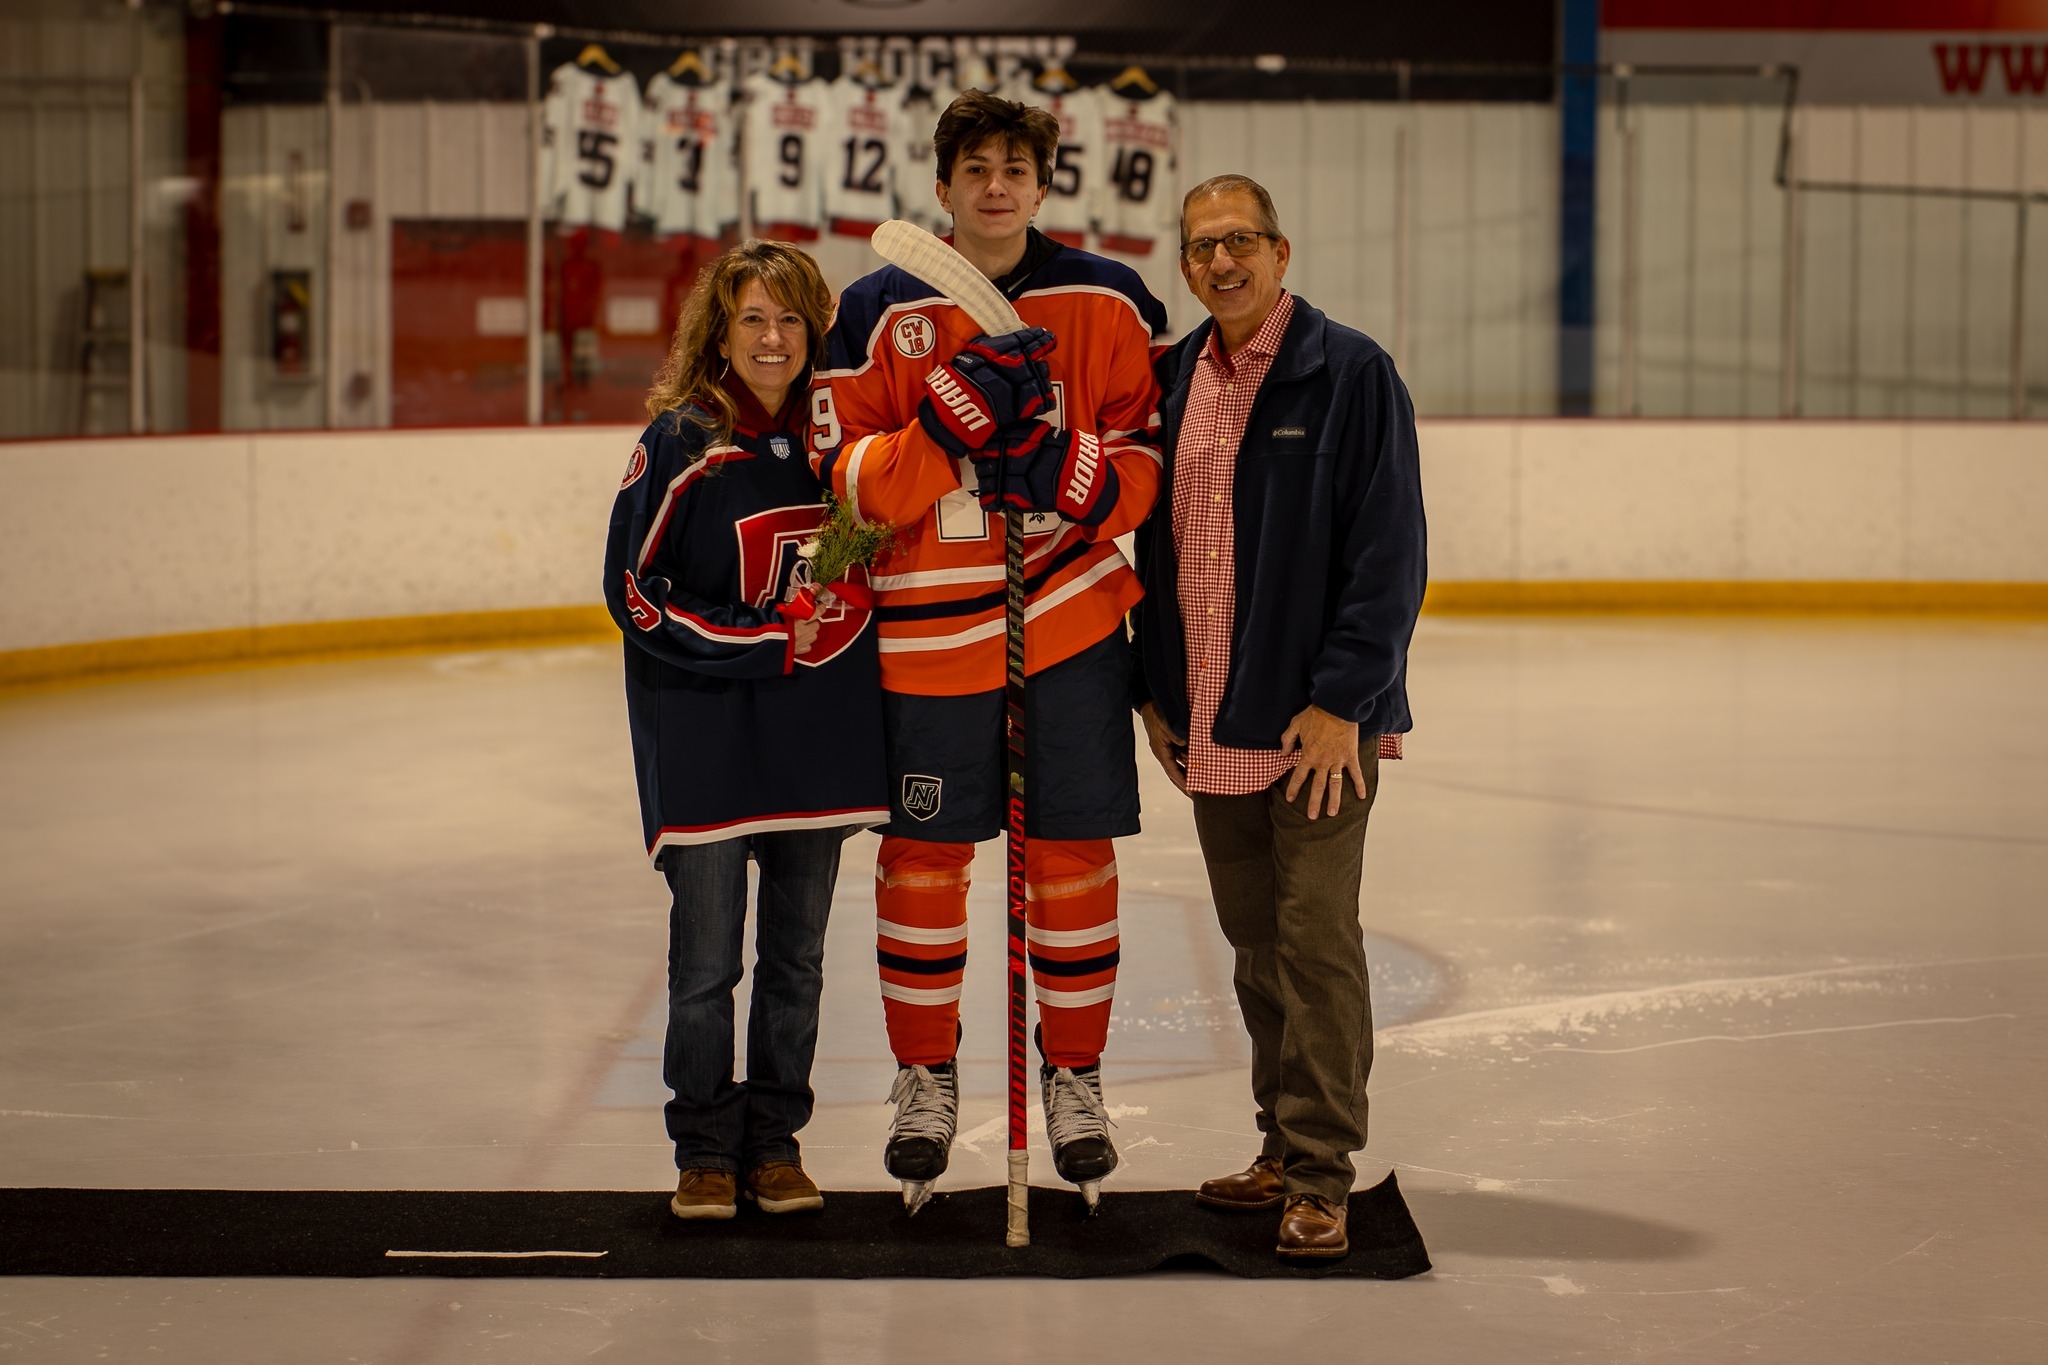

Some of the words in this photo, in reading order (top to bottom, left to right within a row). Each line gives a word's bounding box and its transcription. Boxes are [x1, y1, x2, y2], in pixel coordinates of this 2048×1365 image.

[578, 130, 617, 188] 5
[781, 135, 803, 188] 9
[843, 137, 887, 192] 12
[1052, 145, 1083, 196] 5
[1112, 147, 1153, 201] 48
[901, 320, 923, 338] CW
[908, 337, 925, 354] 18
[811, 386, 842, 450] 9
[1277, 428, 1305, 436] Columbia
[1008, 510, 1025, 690] WARRIO
[904, 782, 940, 811] N
[1009, 797, 1025, 921] NOVIUM
